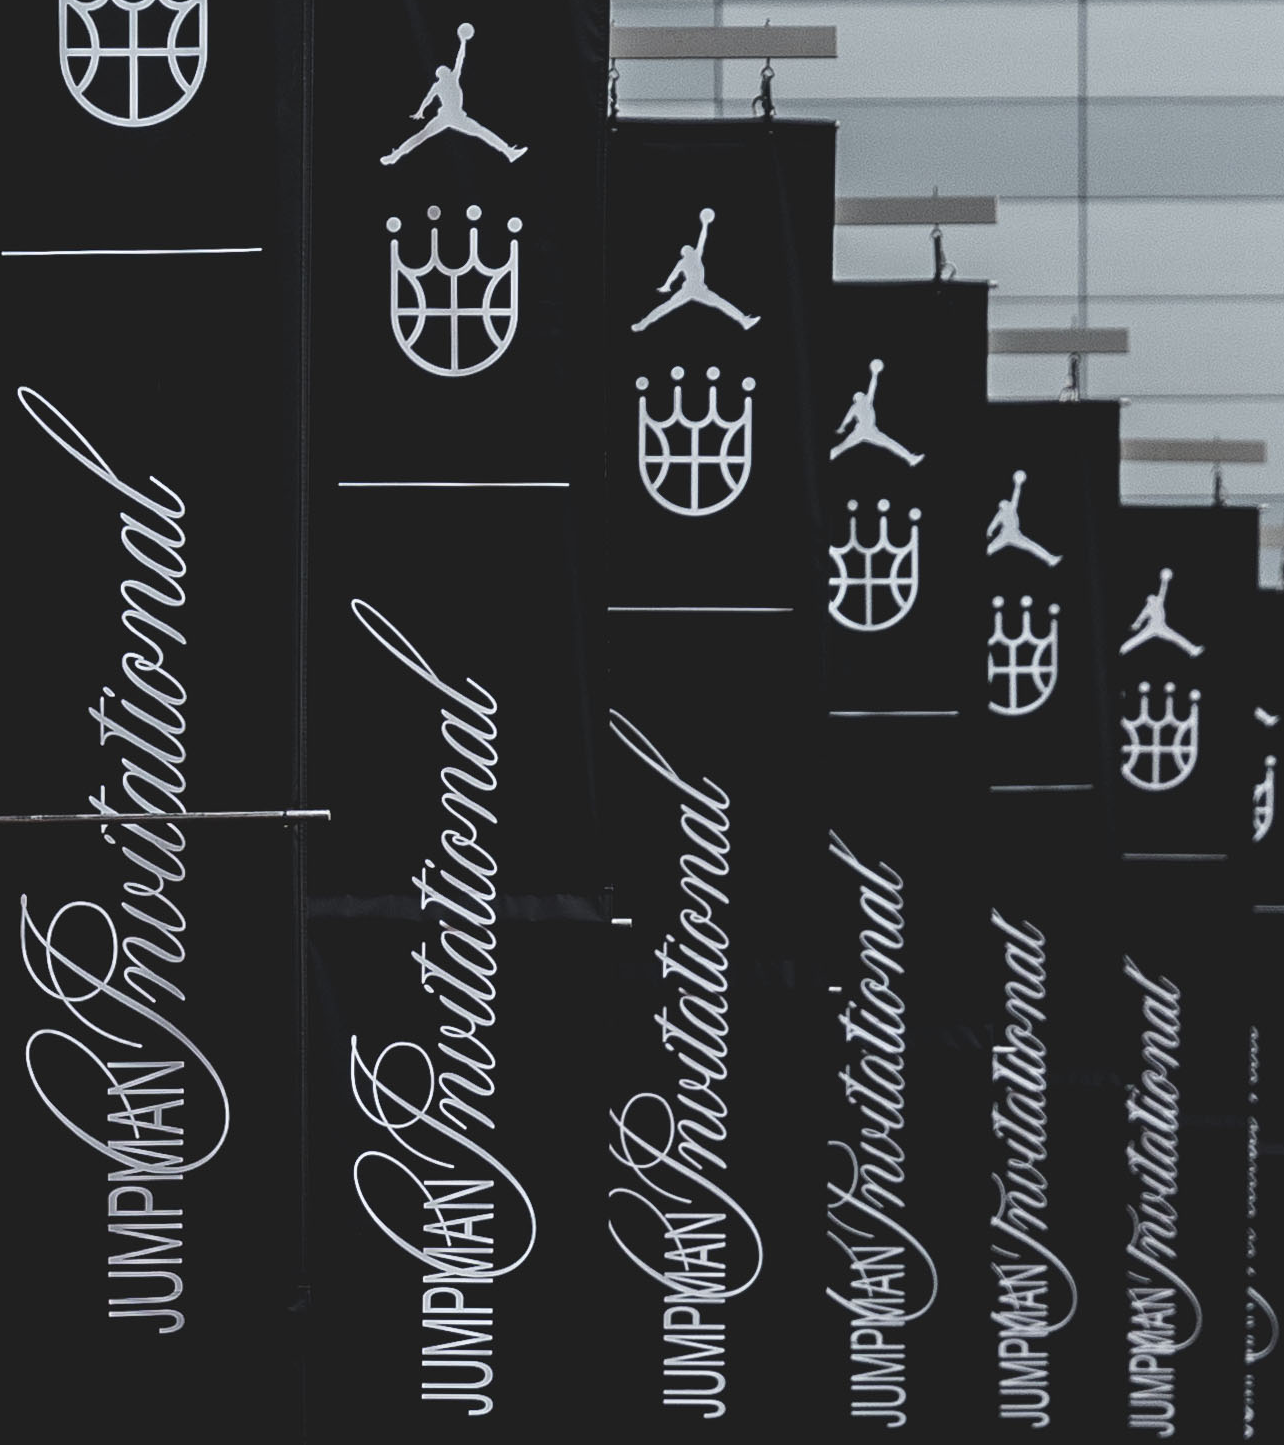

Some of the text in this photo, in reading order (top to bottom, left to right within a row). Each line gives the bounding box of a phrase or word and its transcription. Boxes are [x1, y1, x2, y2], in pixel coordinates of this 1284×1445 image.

[351, 598, 536, 1416] JUMPMAN Invitational
[608, 708, 763, 1419] JUMPMAN Invitational
[107, 1060, 185, 1333] JUMPMAN
[850, 1245, 907, 1429] JUMPMAN
[998, 1263, 1051, 1429] JUMPMAN
[1127, 1287, 1176, 1439] JUMPMAN
